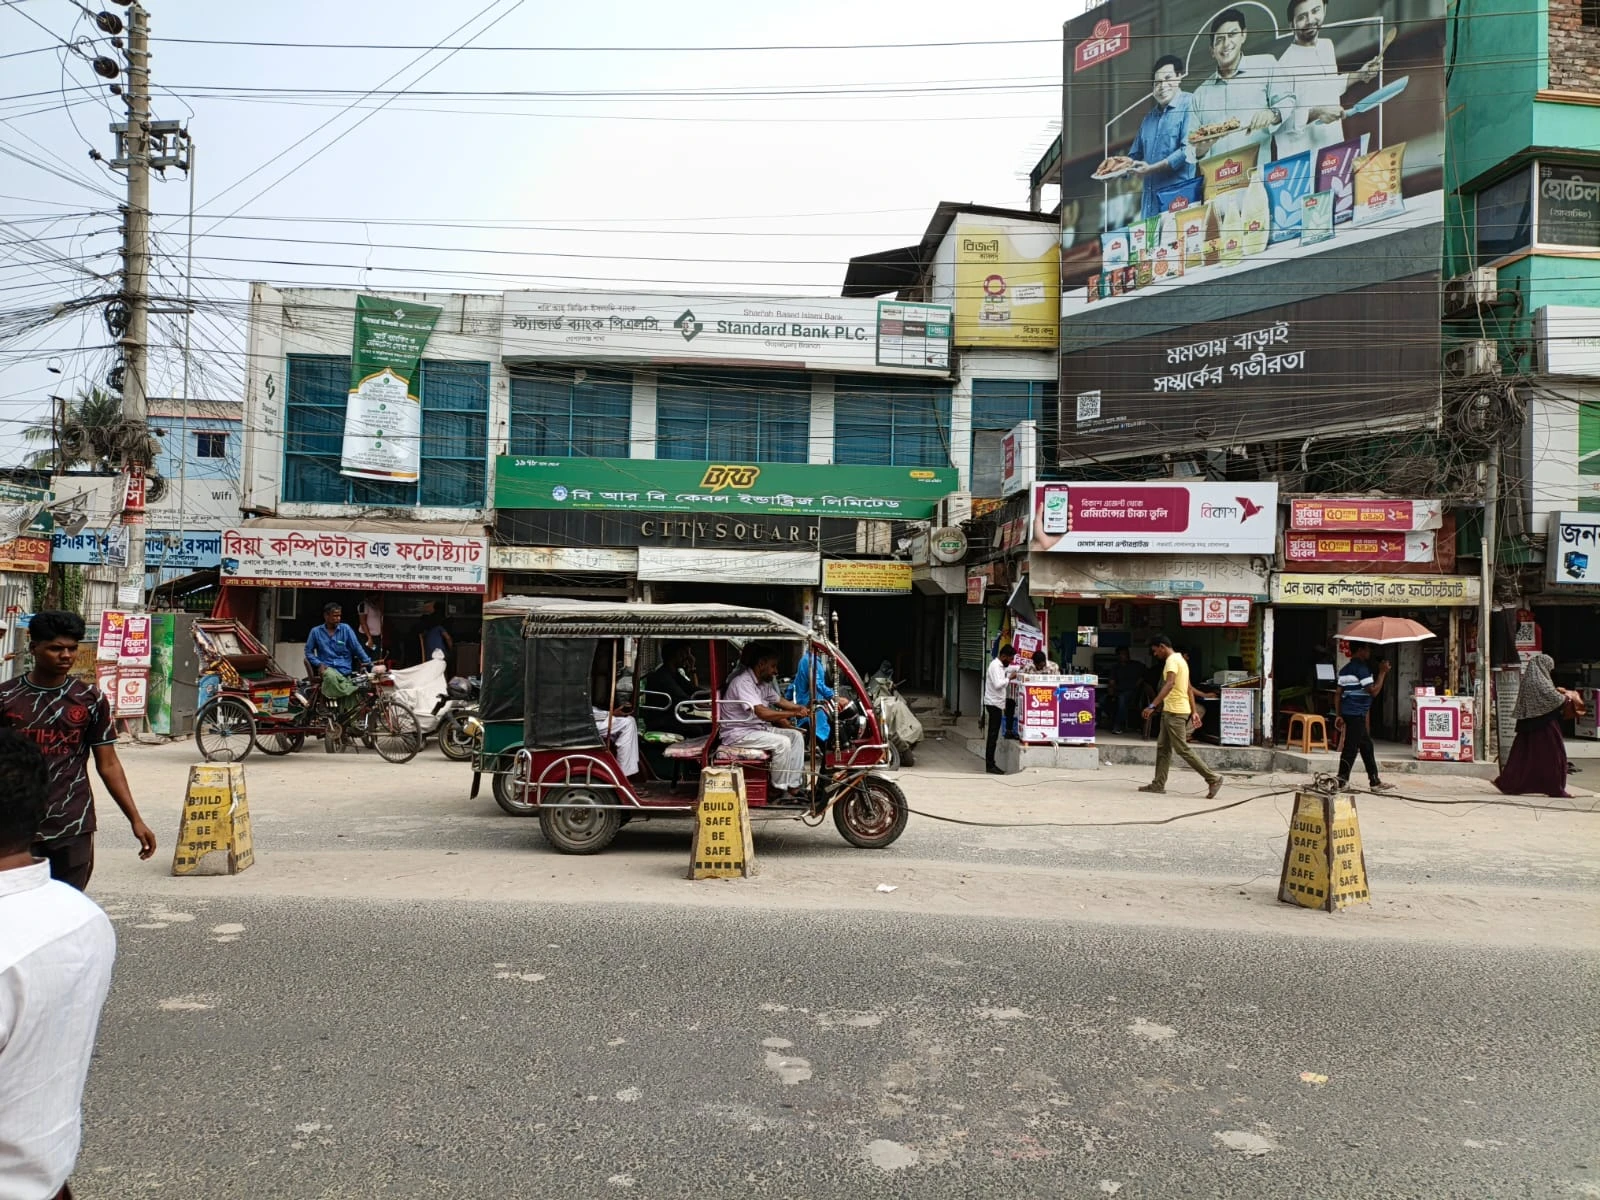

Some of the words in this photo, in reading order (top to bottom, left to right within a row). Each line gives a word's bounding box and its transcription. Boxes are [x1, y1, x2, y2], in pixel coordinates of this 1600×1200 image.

[1083, 33, 1121, 60] তীর
[568, 318, 603, 332] ব্যাংক
[716, 319, 787, 336] Standard
[792, 323, 830, 339] Bank
[835, 328, 868, 341] PLC.
[1167, 337, 1228, 364] মমতায়
[1233, 321, 1290, 352] বাড়াই
[1153, 363, 1224, 392] সম্পর্কের
[1230, 350, 1305, 380] গভীরতা
[703, 466, 758, 490] BRB
[211, 490, 233, 501] Wifi
[571, 488, 593, 501] বি
[599, 490, 640, 502] আর
[646, 490, 668, 502] বি
[675, 492, 729, 504] কেবল
[822, 495, 901, 509] লিমিটেড
[1127, 507, 1147, 518] টাকা
[1149, 507, 1169, 520] তুলি
[1201, 502, 1237, 519] বিকাশ
[1560, 523, 1600, 547] জন
[19, 540, 46, 554] BCS
[269, 532, 368, 560] কম্পিউটার
[370, 542, 391, 557] এন্ড
[1284, 580, 1300, 596] এন
[1303, 581, 1324, 596] আর
[188, 795, 222, 806] BUILD
[703, 802, 734, 811] BUILD
[190, 810, 218, 821] SAFE
[705, 817, 732, 826] SAFE
[196, 825, 211, 836] BE
[1293, 820, 1322, 835] BUILD
[1333, 827, 1355, 839] BUILD
[711, 831, 725, 841] BE
[188, 840, 217, 851] SAFE
[1294, 836, 1319, 850] SAFE
[1336, 843, 1355, 855] SAFE
[705, 846, 731, 856] SAFE
[1298, 852, 1311, 864] BE
[1342, 859, 1352, 870] BE
[1291, 867, 1315, 881] SAFE
[1339, 875, 1358, 887] SAFE
